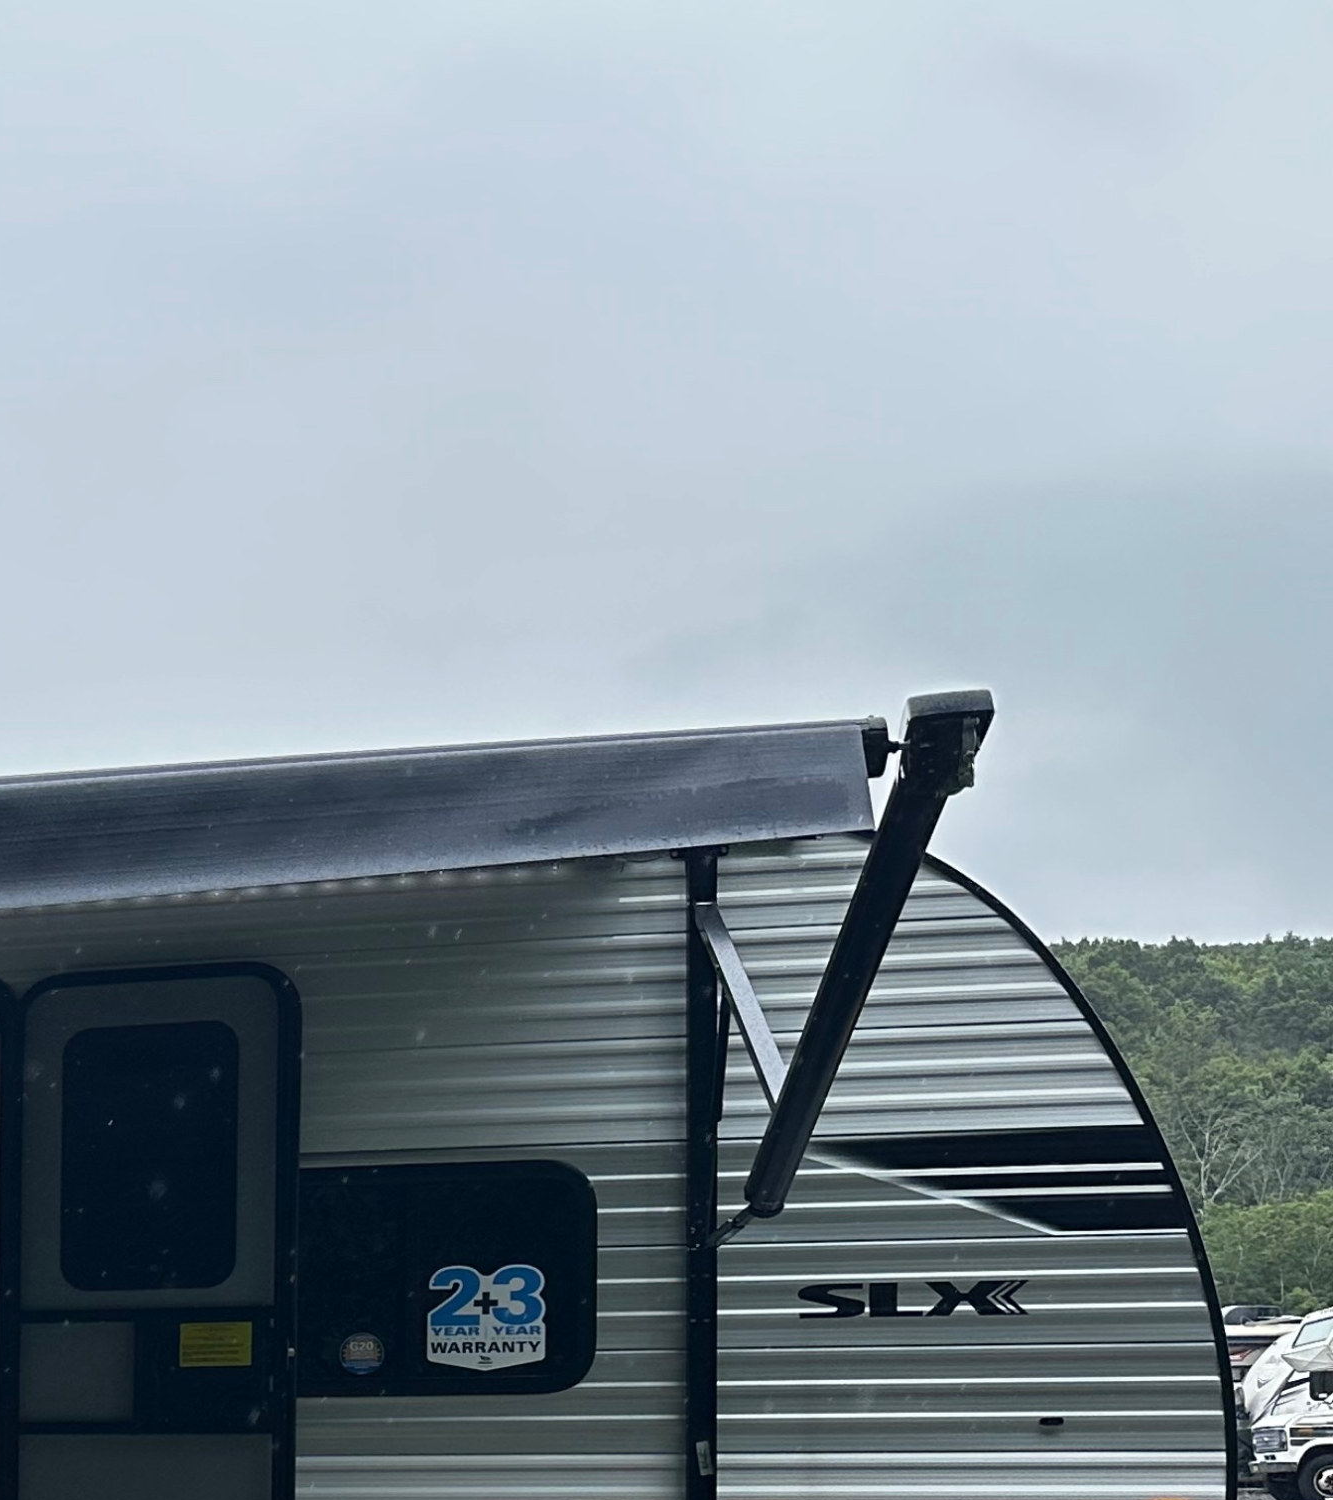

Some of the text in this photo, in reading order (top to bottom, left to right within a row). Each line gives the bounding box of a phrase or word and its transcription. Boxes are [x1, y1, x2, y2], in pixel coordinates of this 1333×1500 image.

[430, 1265, 543, 1325] 2+3
[798, 1280, 1028, 1318] SLX
[431, 1325, 541, 1336] YEAR YEAR
[430, 1341, 541, 1353] WARRANTY
